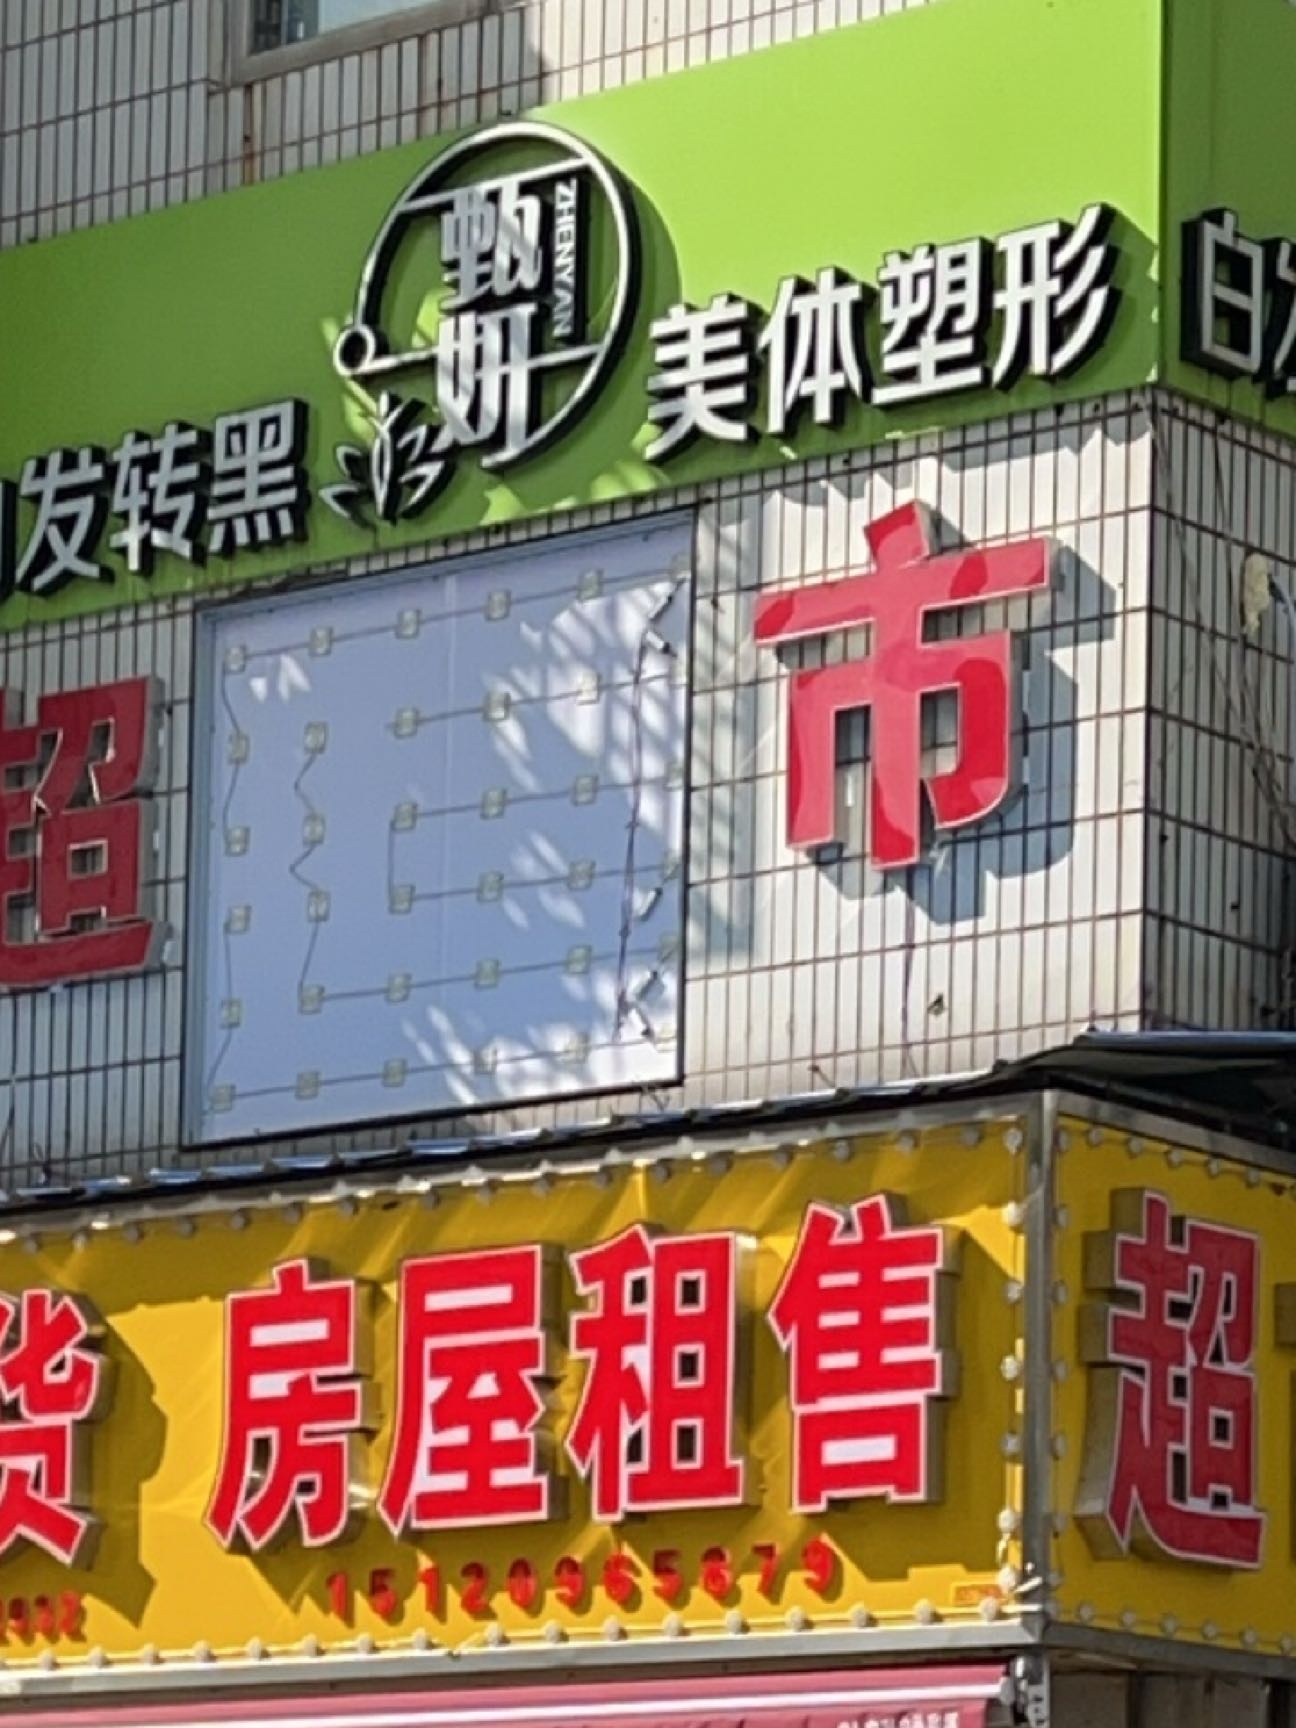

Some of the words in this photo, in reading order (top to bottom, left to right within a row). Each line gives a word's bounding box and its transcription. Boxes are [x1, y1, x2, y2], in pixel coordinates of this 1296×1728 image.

[436, 180, 544, 450] 甄妍
[551, 178, 578, 338] ZHENYAN
[644, 203, 1110, 462] 美体塑形
[754, 499, 1052, 870] 市
[204, 1192, 946, 1550] 房屋租售
[1107, 1189, 1267, 1570] 超
[326, 1532, 838, 1622] 15120965879
